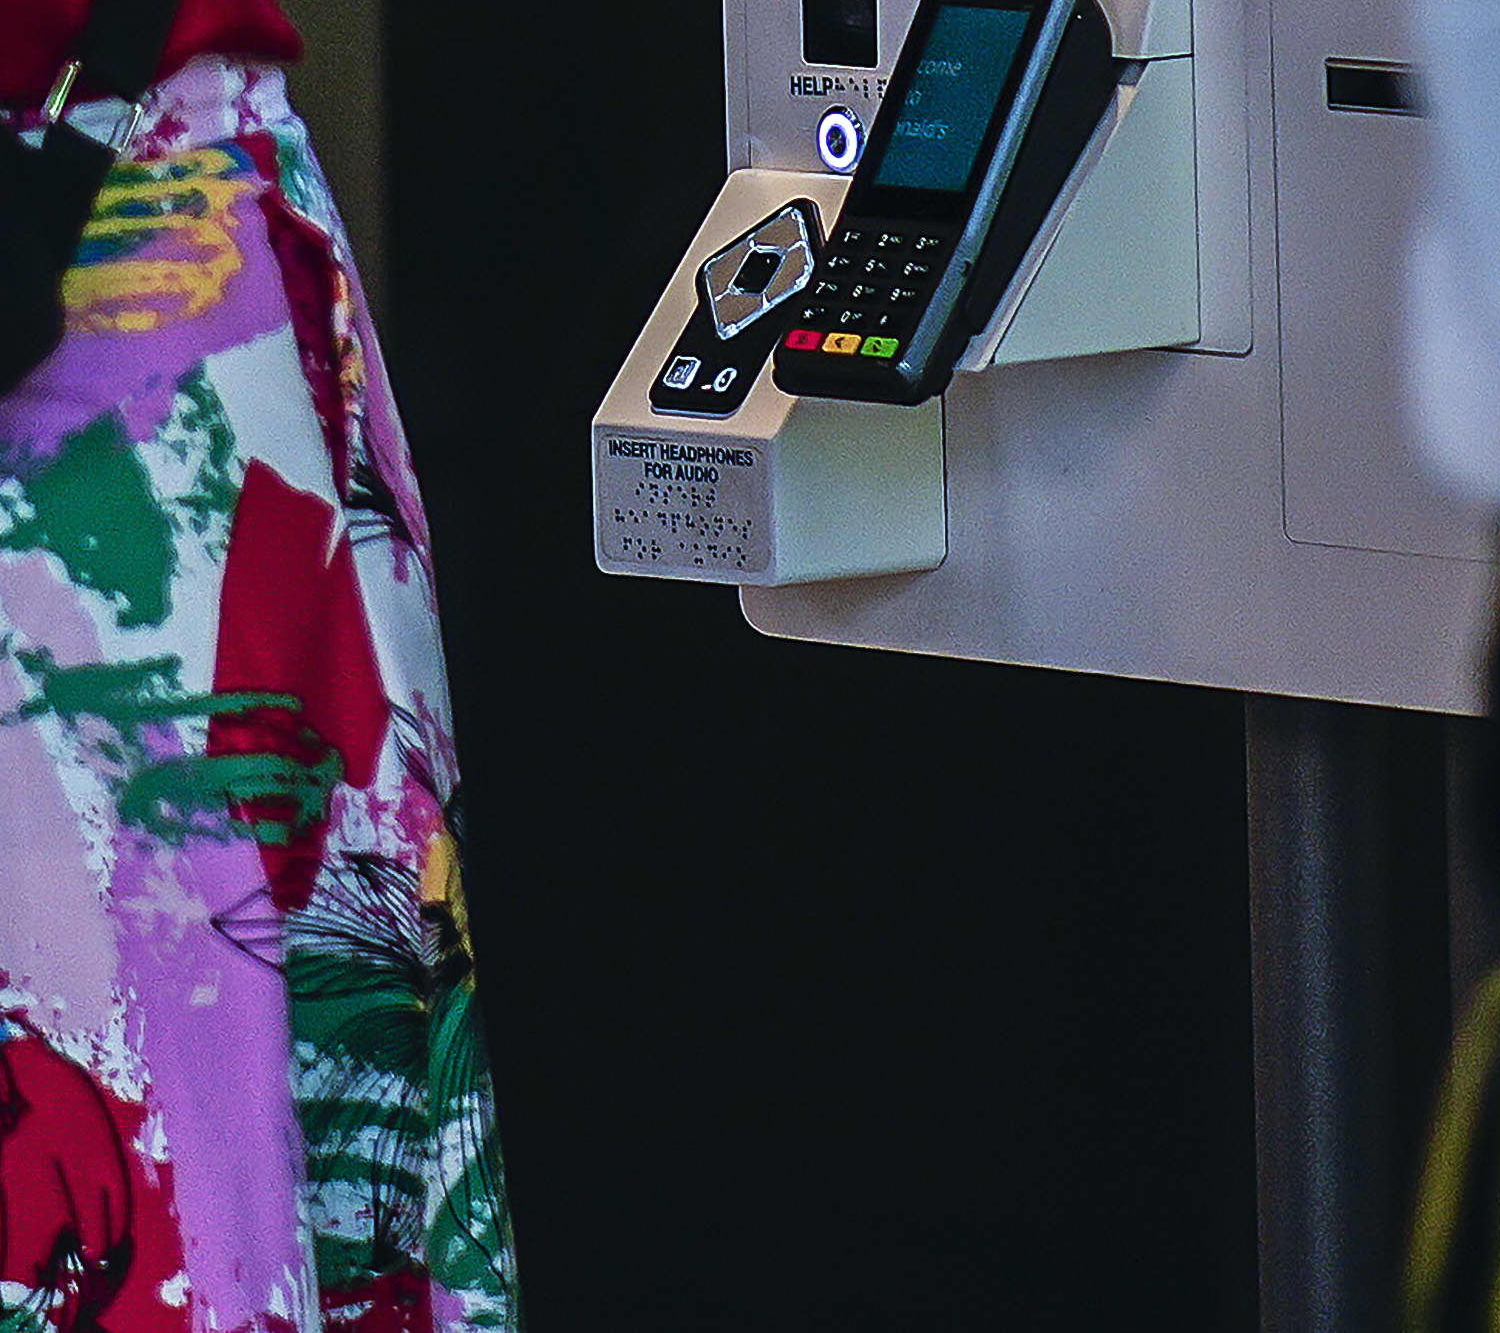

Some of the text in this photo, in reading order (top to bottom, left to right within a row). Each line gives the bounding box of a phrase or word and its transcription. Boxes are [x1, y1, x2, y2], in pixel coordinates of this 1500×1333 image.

[790, 76, 833, 97] HELP
[608, 439, 754, 467] INSERT HEADPHONES
[644, 462, 719, 484] FOR AUDIO
